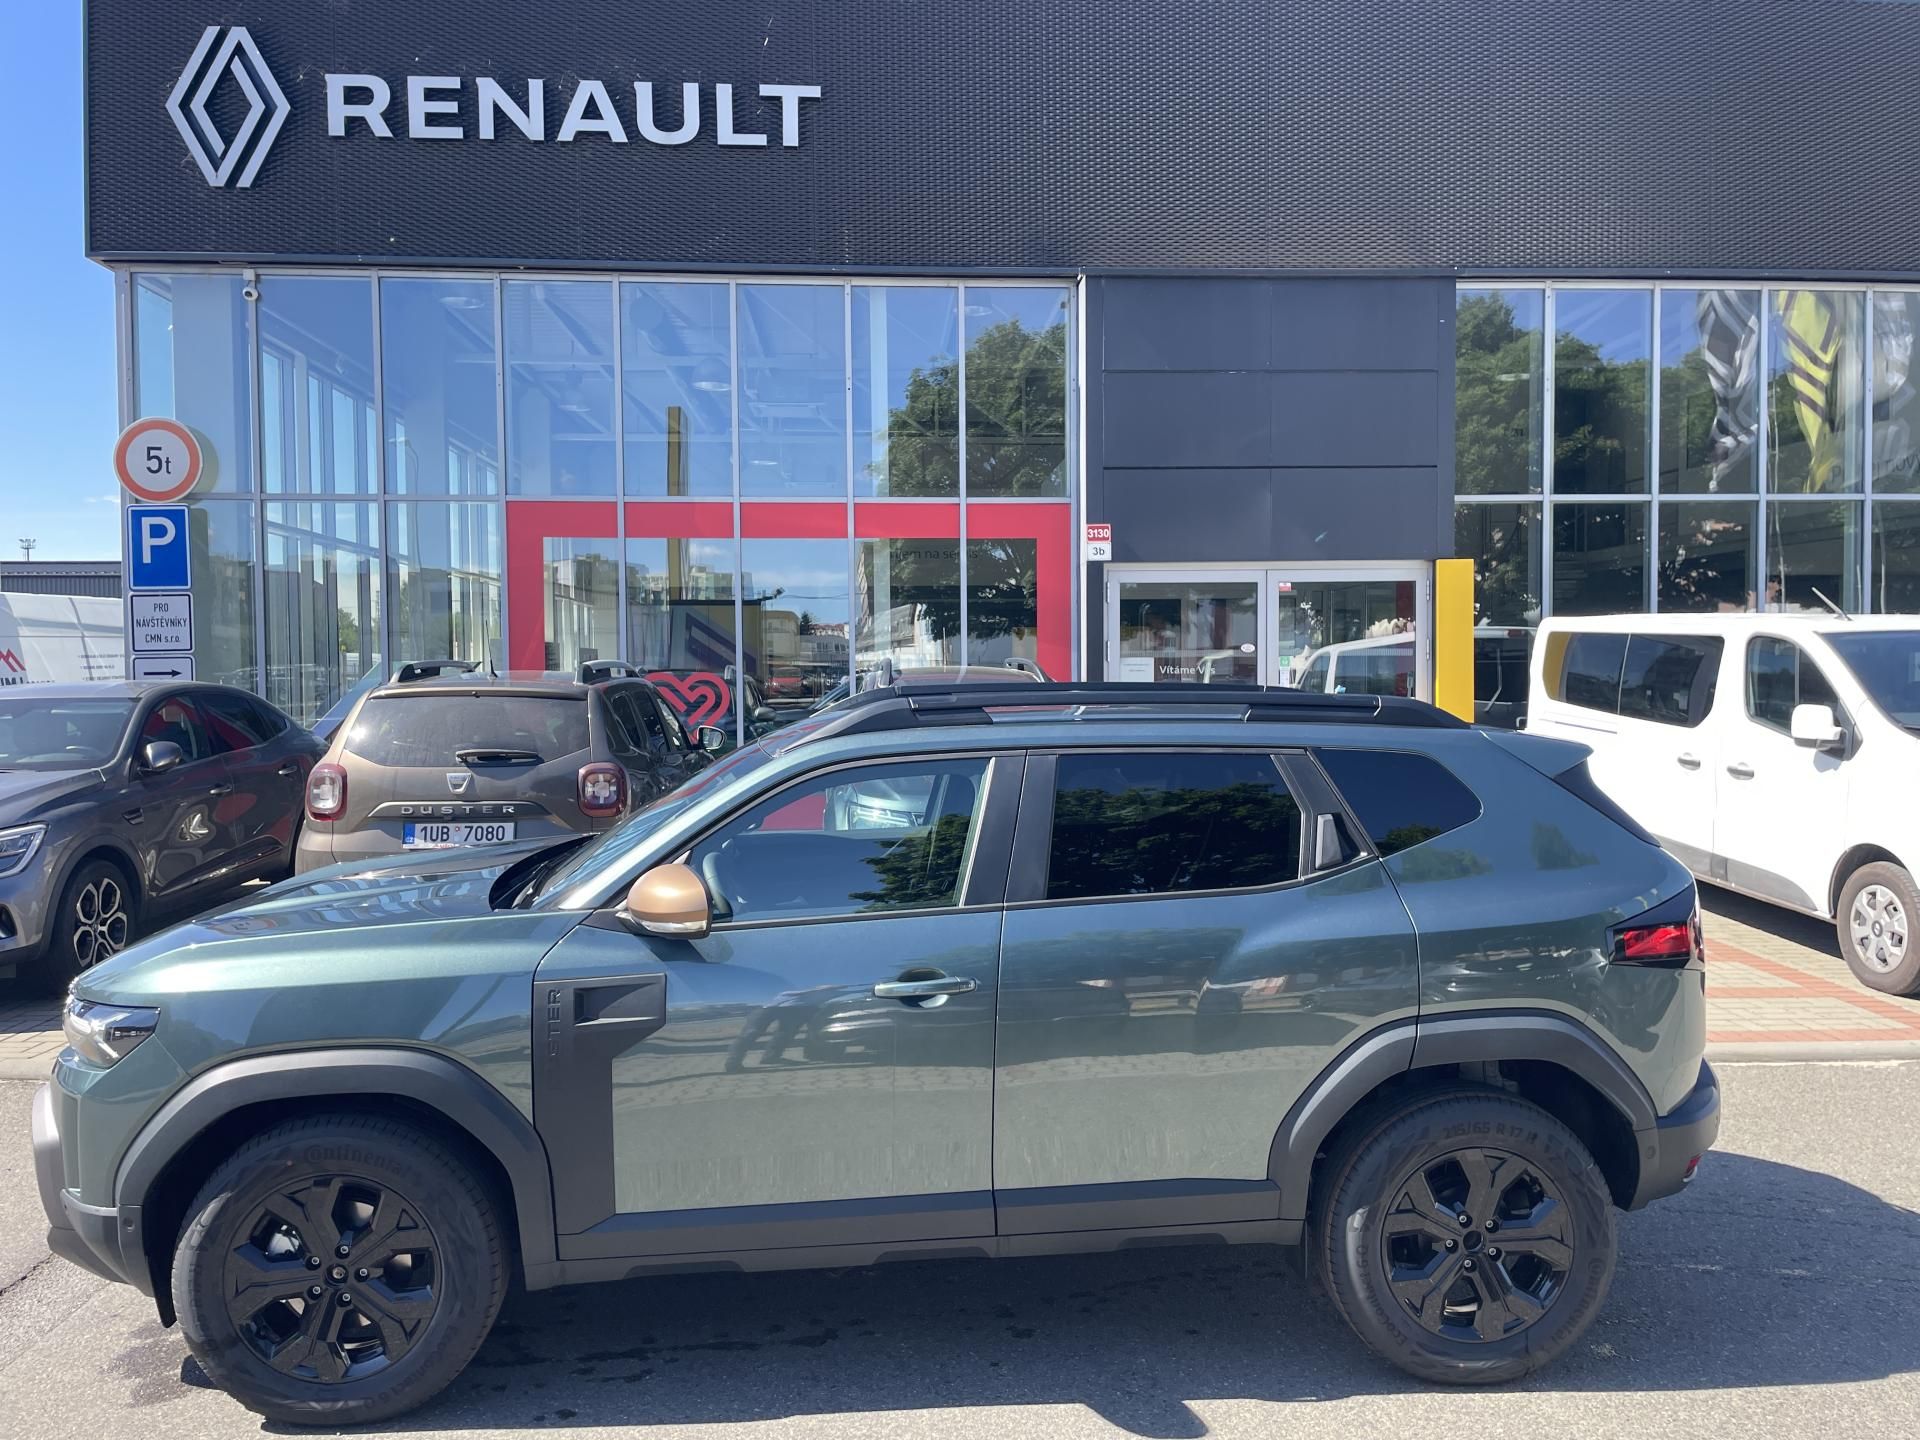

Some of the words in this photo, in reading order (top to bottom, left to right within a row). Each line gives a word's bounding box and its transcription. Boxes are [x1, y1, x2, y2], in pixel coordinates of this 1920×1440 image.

[324, 73, 822, 147] RENAULT
[146, 446, 172, 474] 5t
[1088, 528, 1109, 538] 3130
[140, 516, 176, 563] P
[924, 550, 940, 559] na
[1092, 546, 1105, 556] 3b
[153, 603, 169, 613] PRO
[136, 616, 187, 628] NÁVŠTĚVNÍKY
[145, 633, 162, 643] CMN
[1159, 664, 1196, 675] Vítáme
[1198, 665, 1216, 675] Vs
[401, 806, 515, 815] DUSTER
[420, 826, 450, 842] 1UB
[464, 826, 505, 842] 7080
